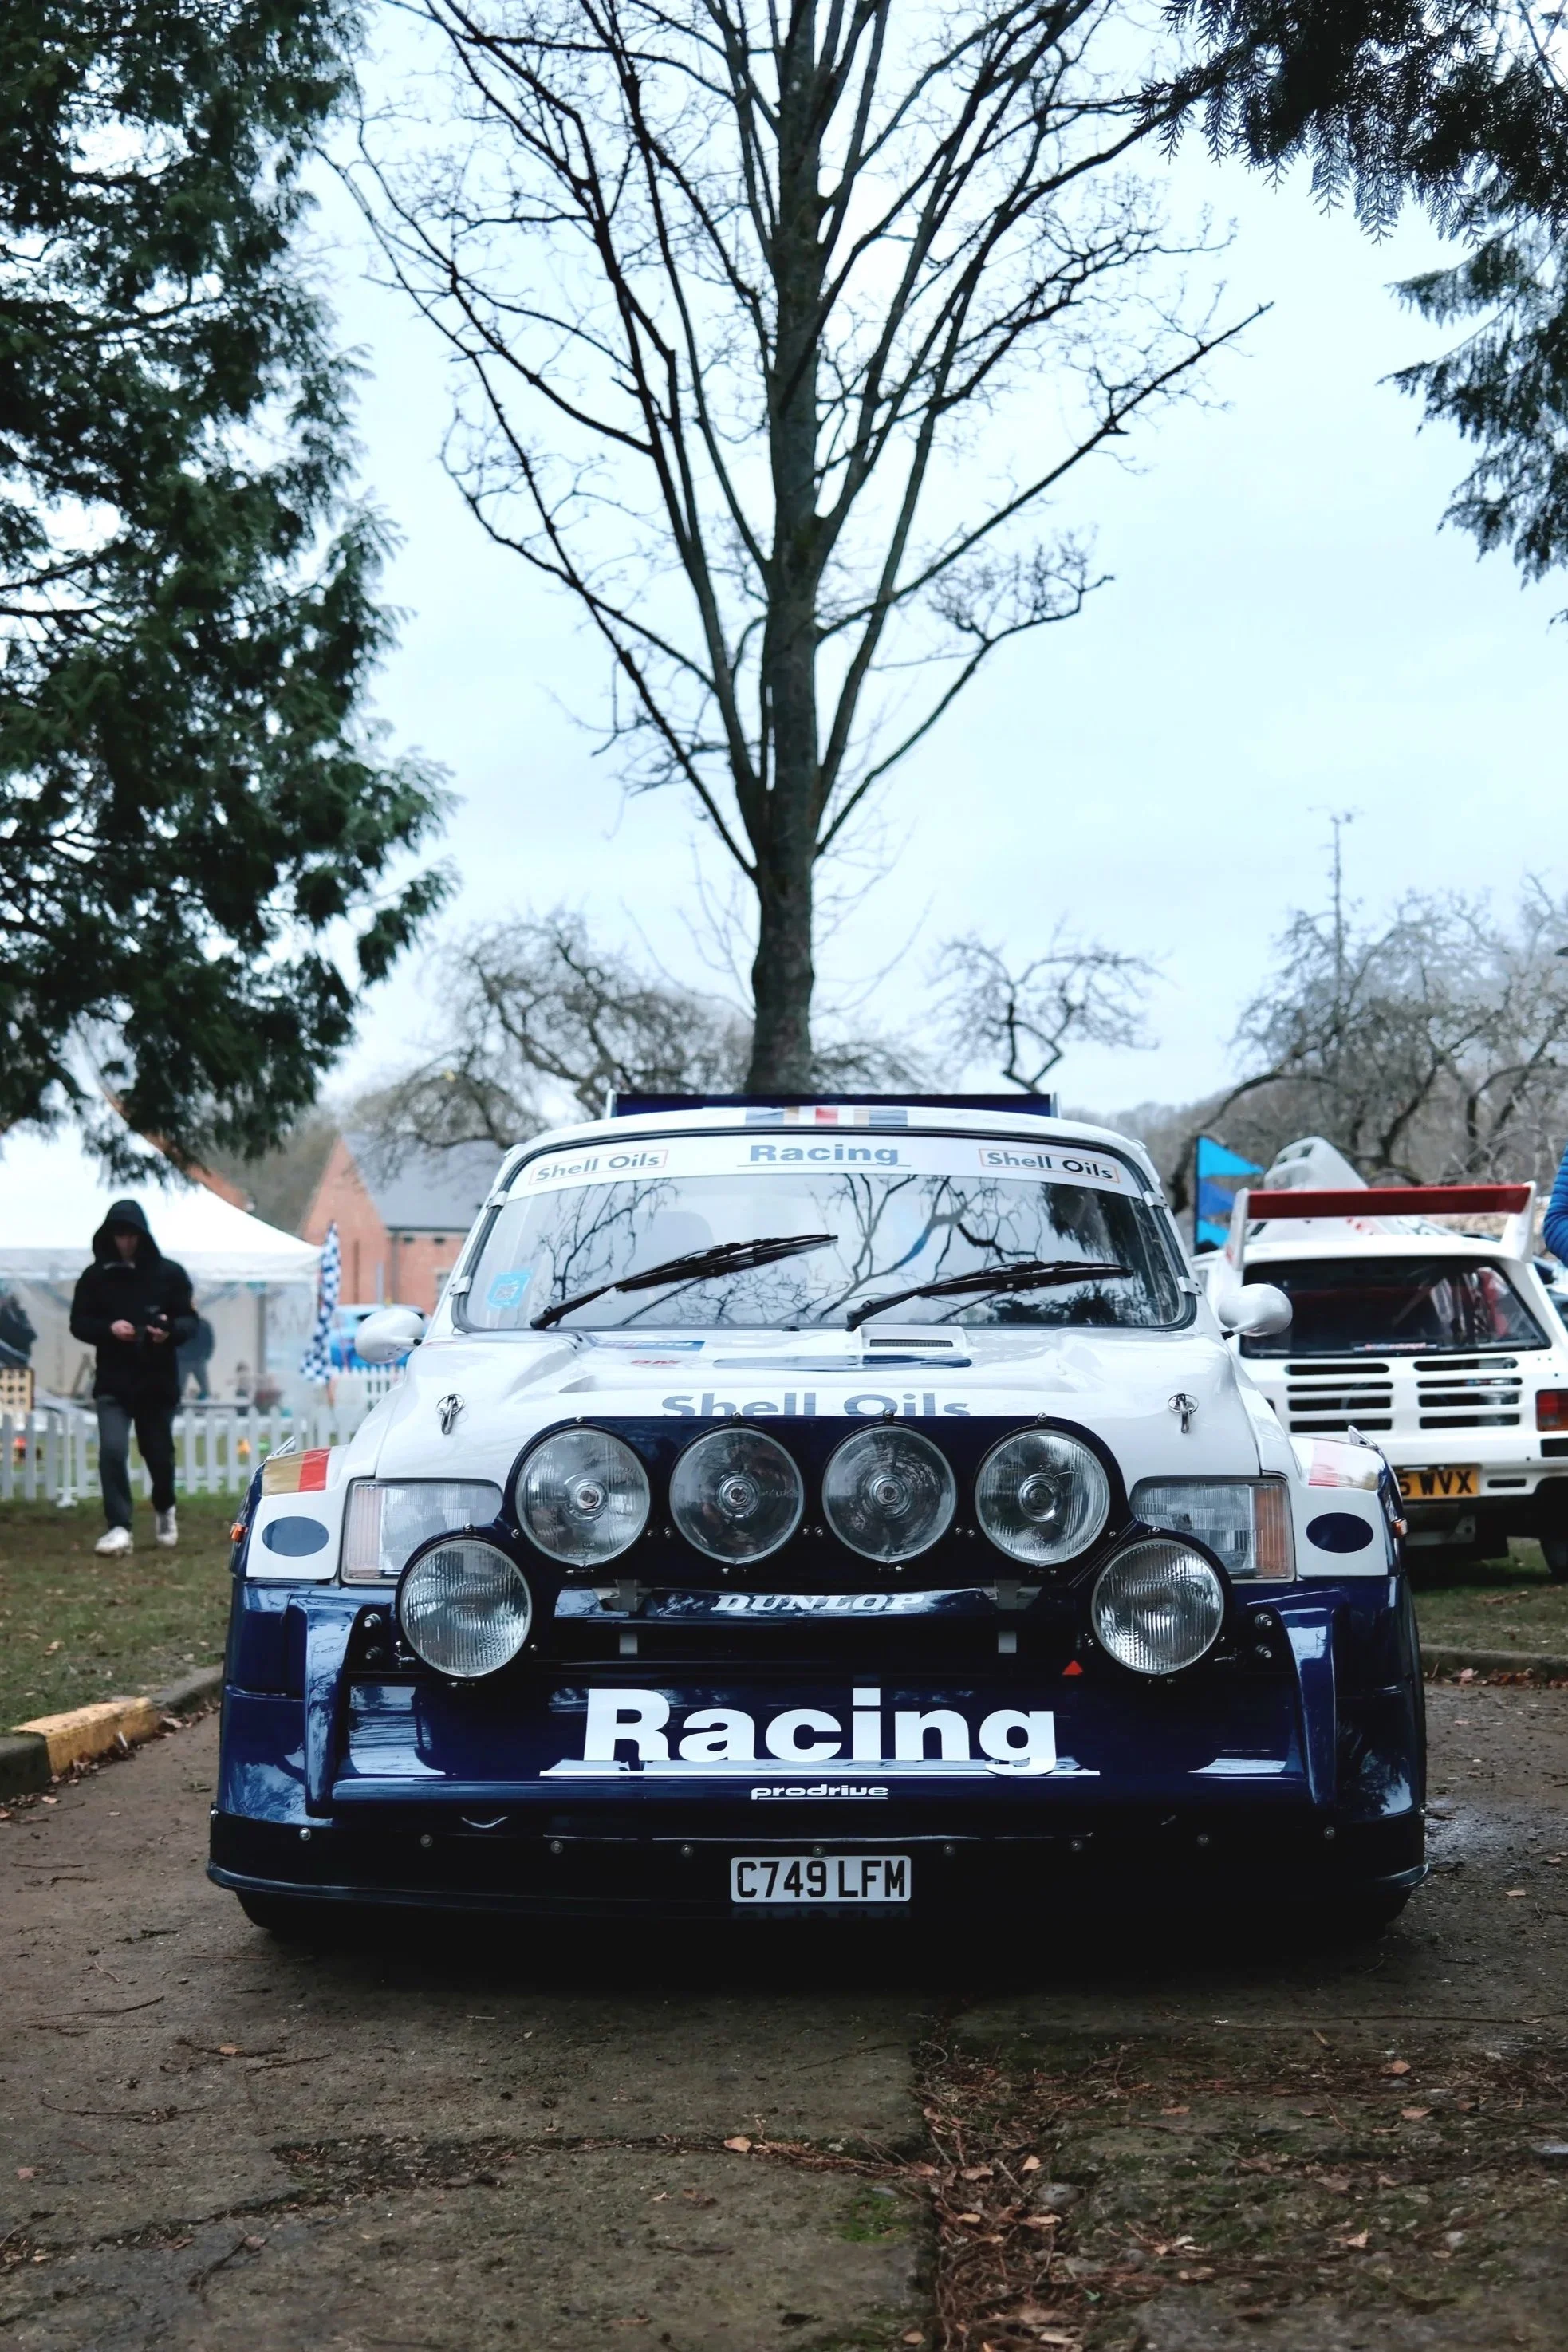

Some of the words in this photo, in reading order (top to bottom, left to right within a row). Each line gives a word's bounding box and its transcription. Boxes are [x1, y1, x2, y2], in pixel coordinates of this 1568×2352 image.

[535, 1157, 599, 1181] Shell
[608, 1152, 659, 1169] Oils
[750, 1144, 898, 1166] Racing
[987, 1152, 1053, 1169] Shell
[1062, 1160, 1113, 1179] Oils
[661, 1392, 817, 1416] Shell
[843, 1393, 979, 1416] Oils
[1419, 1470, 1473, 1495] WVX
[710, 1594, 924, 1611] DUNLOP
[583, 1688, 1057, 1776] Racing
[751, 1783, 888, 1800] prodrive
[737, 1860, 827, 1898] C749
[838, 1860, 905, 1897] LFM
